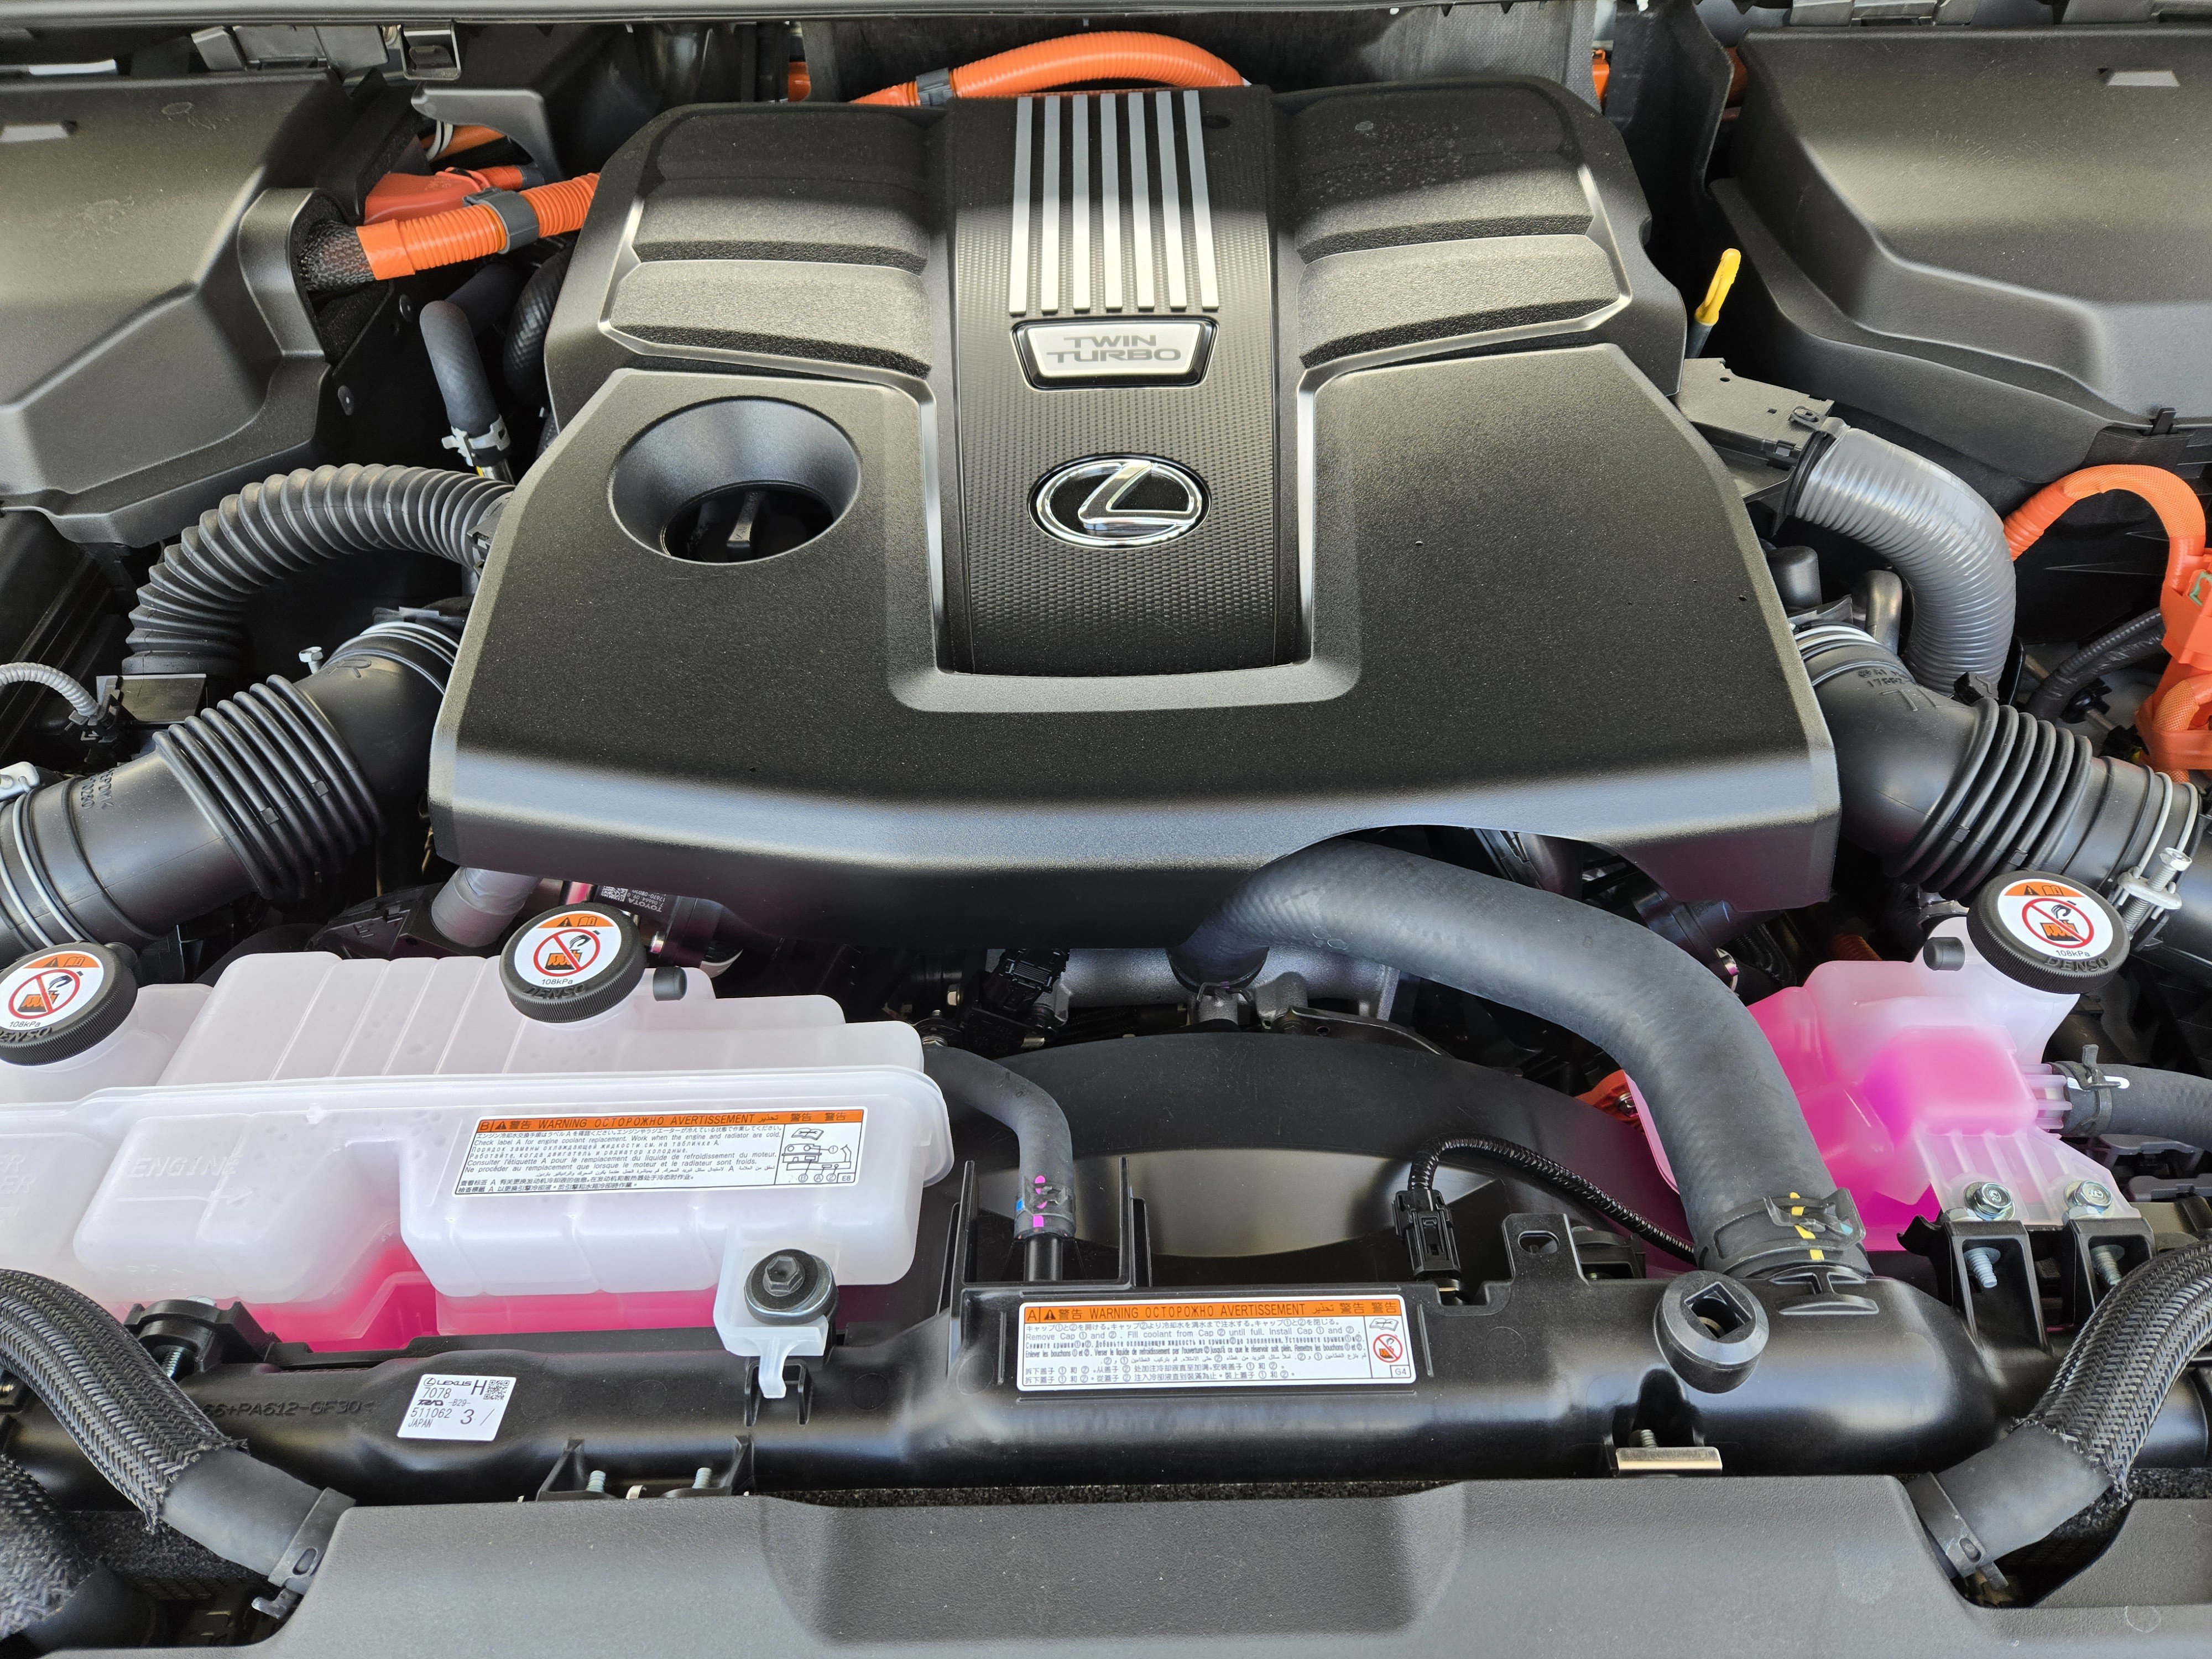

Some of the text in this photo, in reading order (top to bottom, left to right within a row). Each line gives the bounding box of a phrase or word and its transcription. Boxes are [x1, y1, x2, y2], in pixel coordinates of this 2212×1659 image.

[1063, 335, 1157, 347] TWIN
[1046, 348, 1182, 363] TURBO
[628, 898, 662, 913] TOYOTA
[2045, 956, 2109, 973] DENSO
[522, 984, 586, 998] DENSO
[0, 1027, 53, 1043] ENSO
[479, 1121, 490, 1131] B
[509, 1120, 532, 1130] 警告
[539, 1118, 587, 1129] WARNING
[594, 1117, 664, 1128] ОСТОРОЖНО
[670, 1114, 754, 1125] AVERTISSEMENT
[789, 1112, 812, 1122] 警告
[825, 1110, 847, 1121] 警告
[1027, 1309, 1037, 1321] A
[1058, 1308, 1082, 1320] 警告
[1089, 1307, 1139, 1319] WARNING
[1145, 1305, 1214, 1318] ОСТОРОЖНО
[1220, 1303, 1305, 1316] AVERTISSEMENT
[1339, 1302, 1365, 1314] 警告
[1371, 1301, 1397, 1313] 警告
[1060, 1332, 1076, 1340] Cap
[1091, 1331, 1105, 1339] and
[1143, 1330, 1172, 1338] coolant
[1198, 1329, 1214, 1337] Cap
[1229, 1328, 1245, 1337] until
[1250, 1328, 1265, 1336] full.
[1269, 1327, 1292, 1335] Install
[1297, 1327, 1313, 1335] Cap
[1328, 1326, 1343, 1334] and
[1025, 1350, 1040, 1358] Enlever
[1094, 1348, 1108, 1357] Verser
[1395, 1368, 1407, 1376] G4
[422, 1387, 452, 1399] 7078
[471, 1380, 488, 1395] H
[410, 1407, 452, 1418] 511062
[460, 1409, 475, 1425] 3
[408, 1418, 433, 1428] JAPAN
